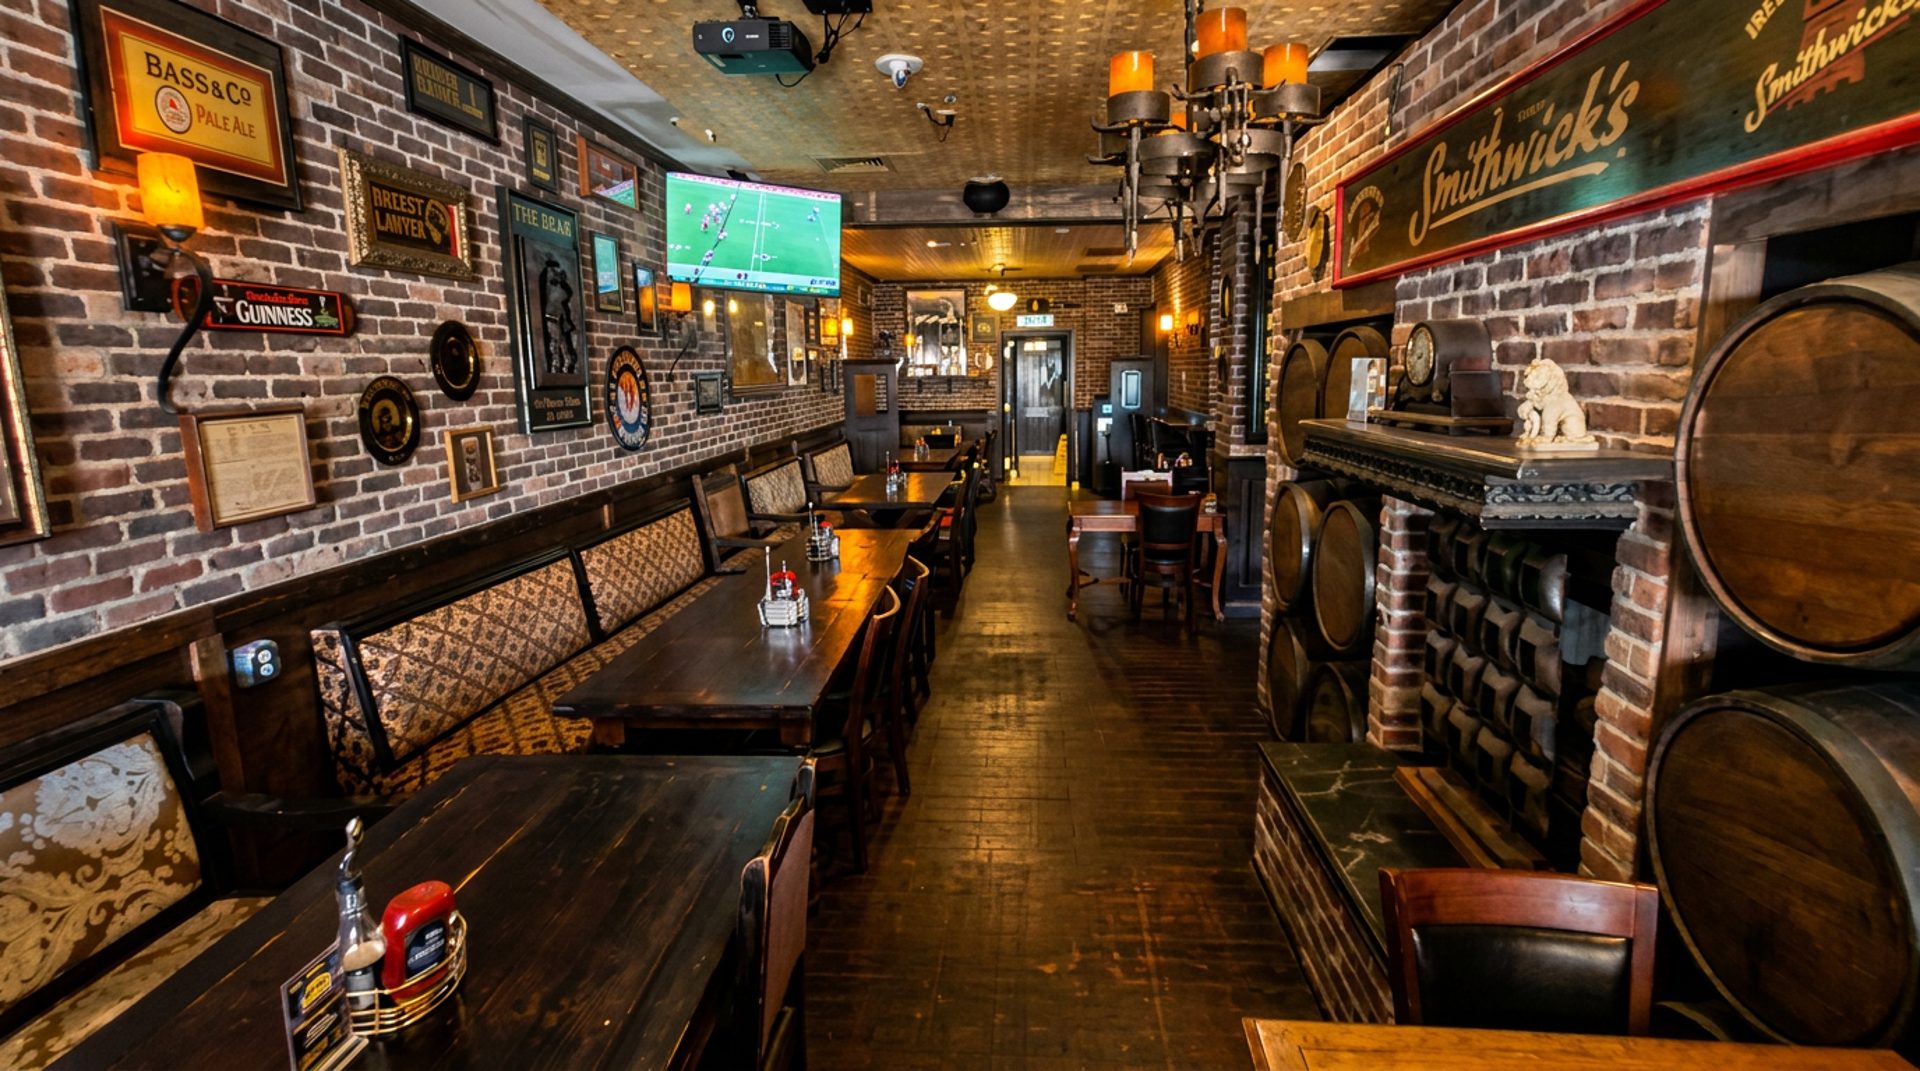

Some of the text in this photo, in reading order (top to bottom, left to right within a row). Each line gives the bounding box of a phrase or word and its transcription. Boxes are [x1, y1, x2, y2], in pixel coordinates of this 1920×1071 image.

[195, 103, 231, 132] PALE
[232, 116, 257, 139] ALE
[511, 203, 539, 227] THE
[235, 299, 313, 327] GUINNESS
